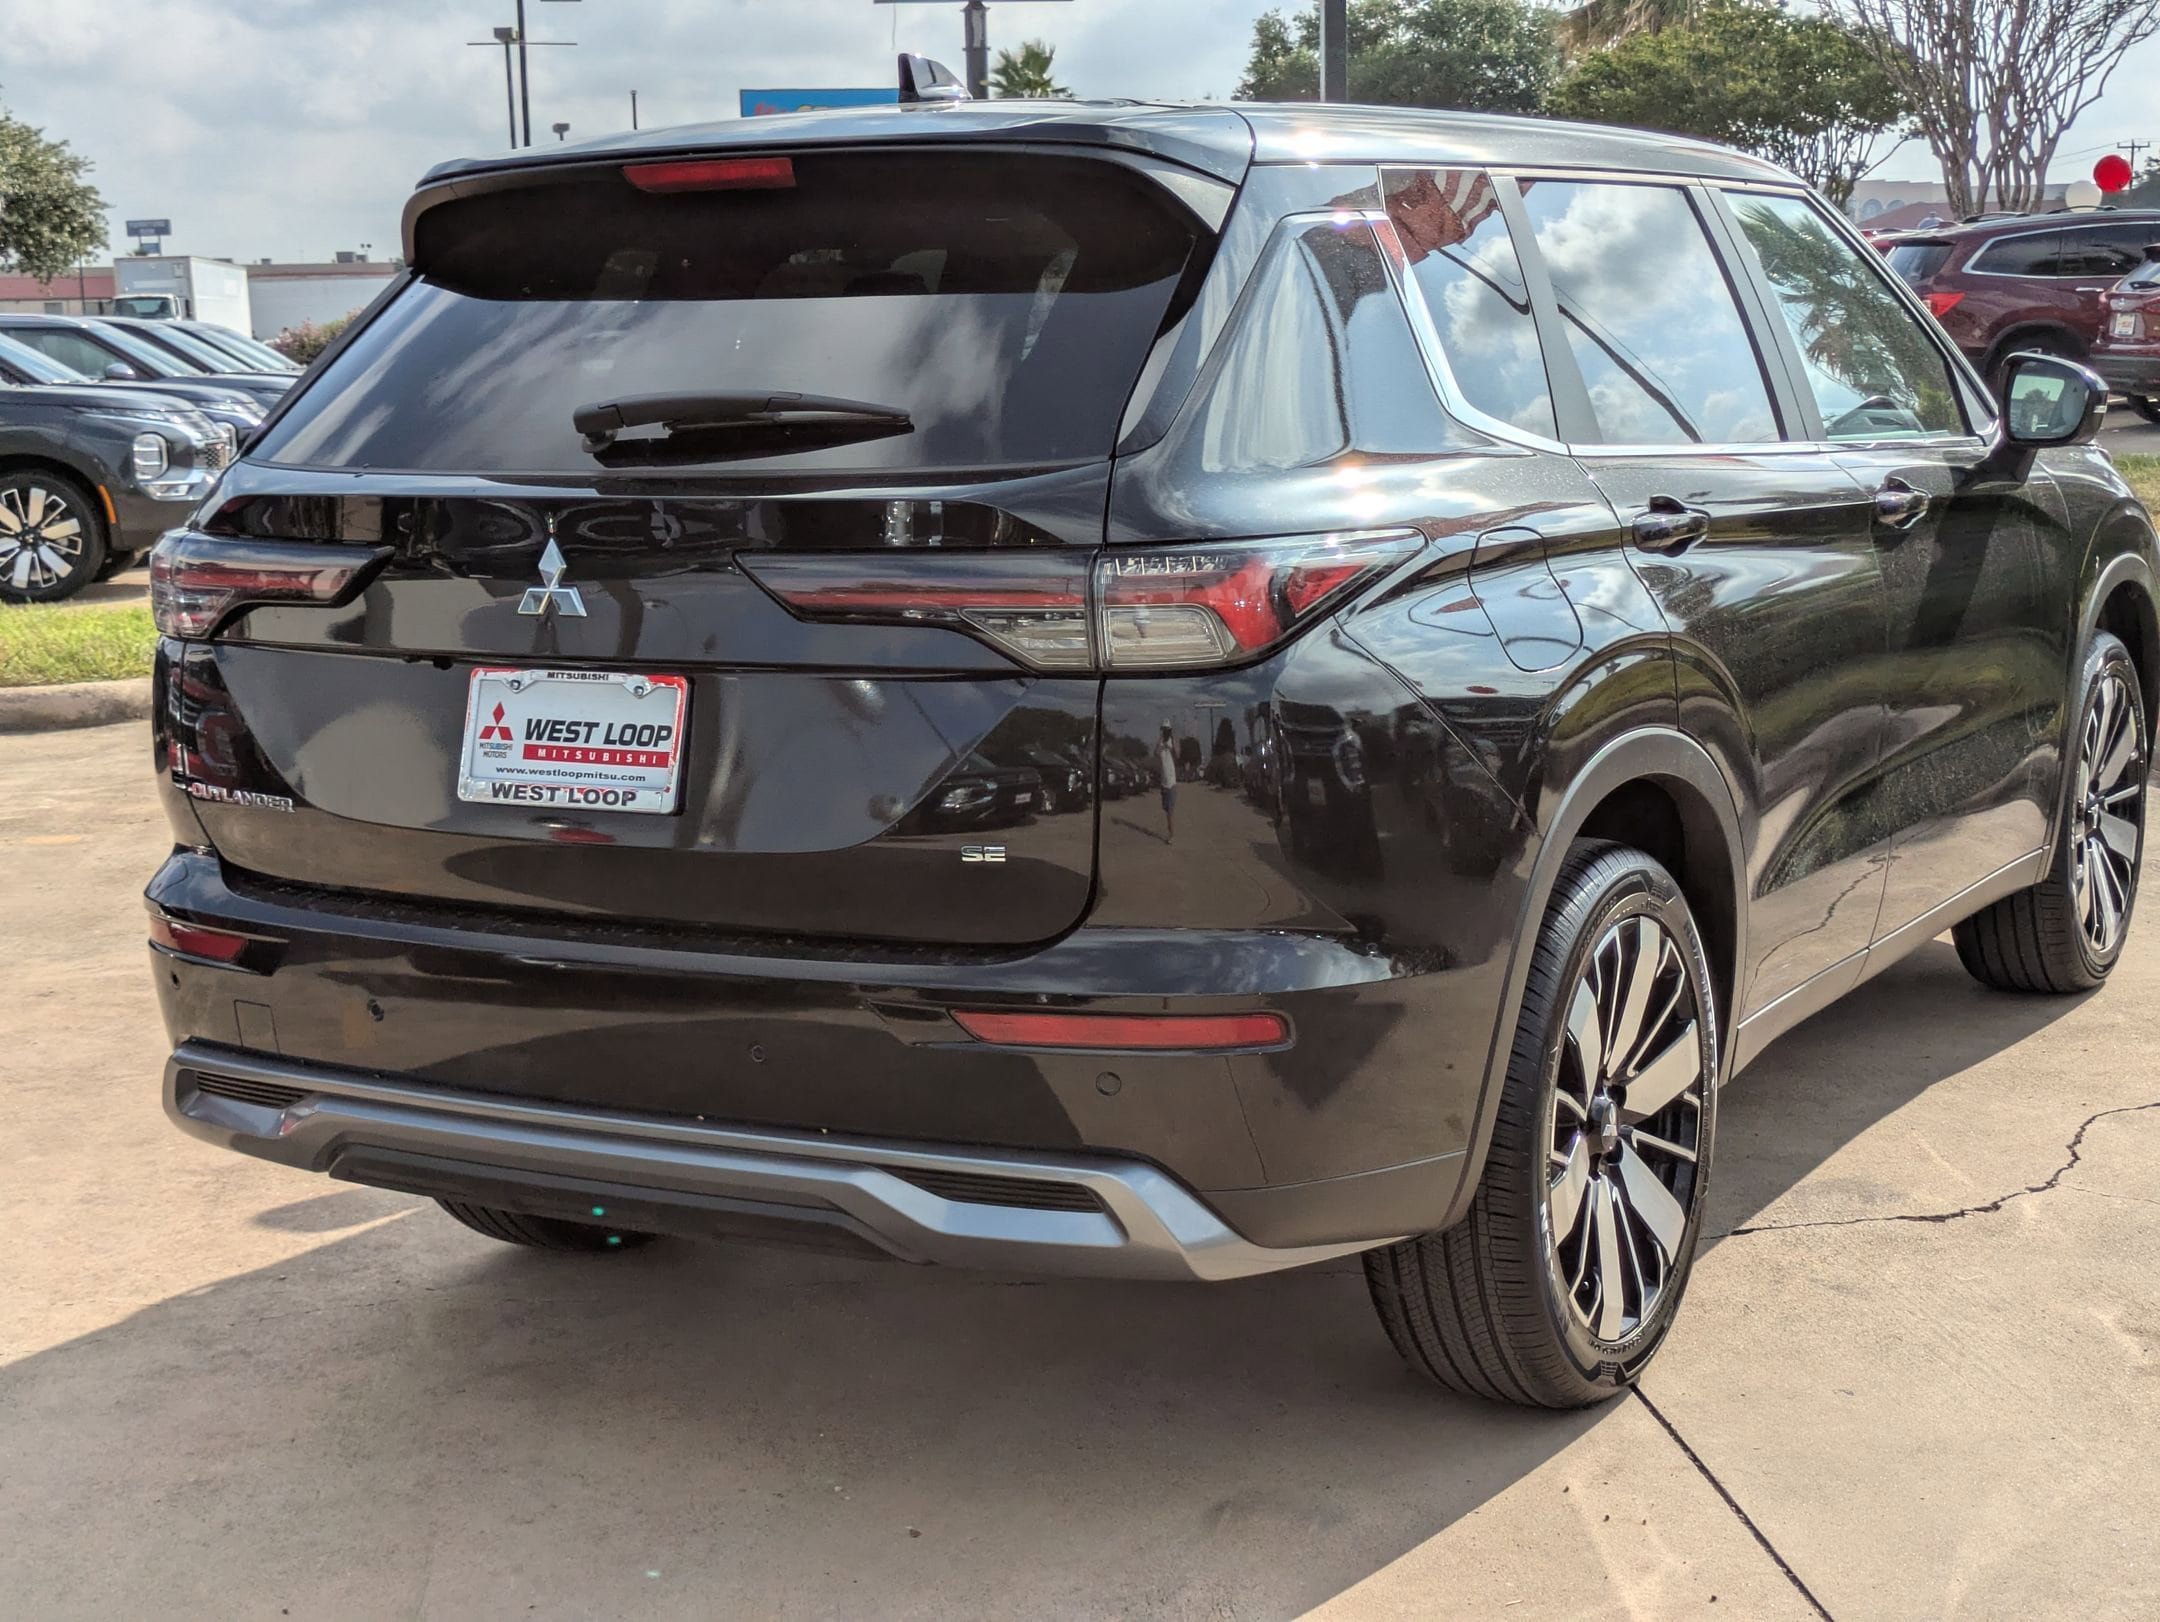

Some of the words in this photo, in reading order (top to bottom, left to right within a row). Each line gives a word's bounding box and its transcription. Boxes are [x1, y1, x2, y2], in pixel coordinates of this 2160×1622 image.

[547, 671, 610, 681] MITSUBISHI
[525, 718, 600, 744] WEST
[603, 722, 673, 748] LOOP
[479, 742, 513, 751] MITSUBISHI
[483, 750, 507, 759] MOTORS
[537, 748, 658, 765] MITSUBISHI
[495, 765, 646, 783] www.westloopmitsu.com
[190, 782, 295, 813] OUTLANDER
[491, 782, 561, 802] WEST
[567, 787, 637, 807] LOOP
[961, 845, 1006, 862] SE
